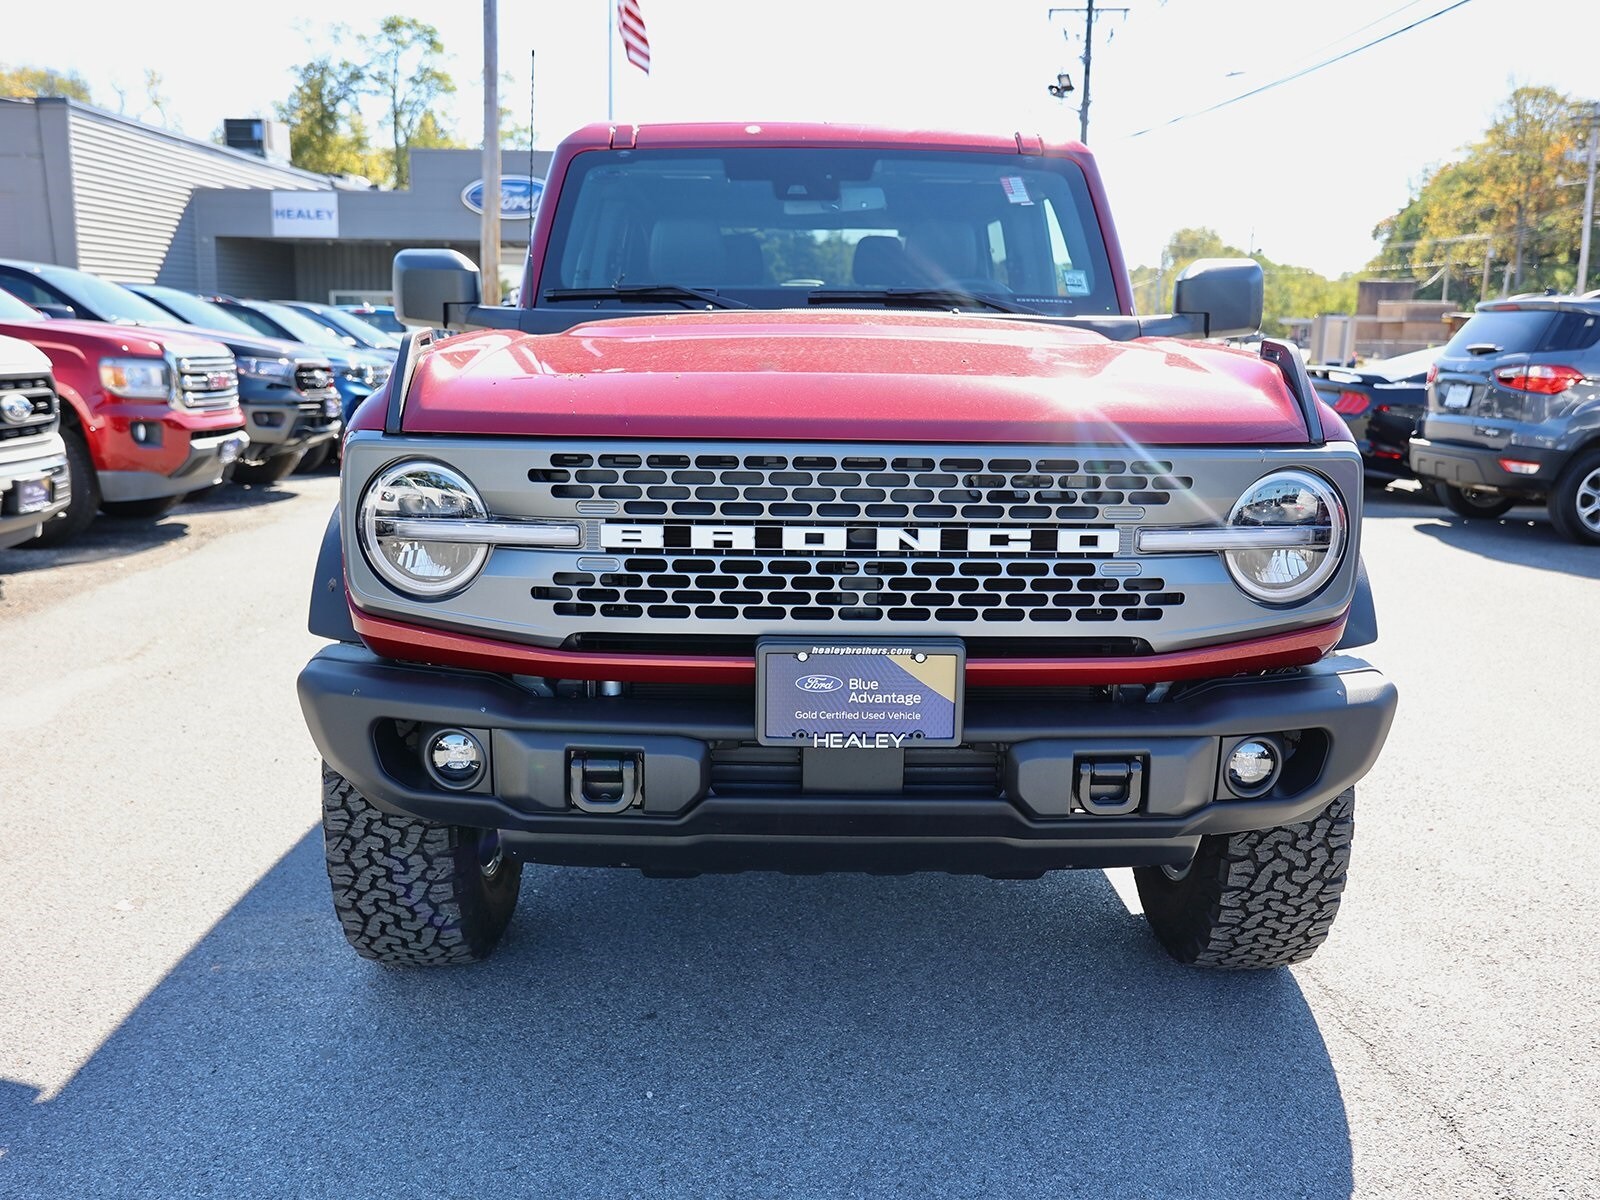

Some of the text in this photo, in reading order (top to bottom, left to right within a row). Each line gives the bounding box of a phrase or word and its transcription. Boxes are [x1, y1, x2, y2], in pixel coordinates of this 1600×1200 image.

[274, 208, 335, 220] HEALEY
[600, 523, 1120, 553] BRONCO
[811, 646, 913, 656] healeybrothers.com
[804, 677, 834, 690] Ford
[849, 678, 879, 690] Blue
[848, 692, 921, 705] Advantage
[794, 711, 921, 720] Gold Certified Used Vehicle
[813, 733, 906, 749] HEALEY
